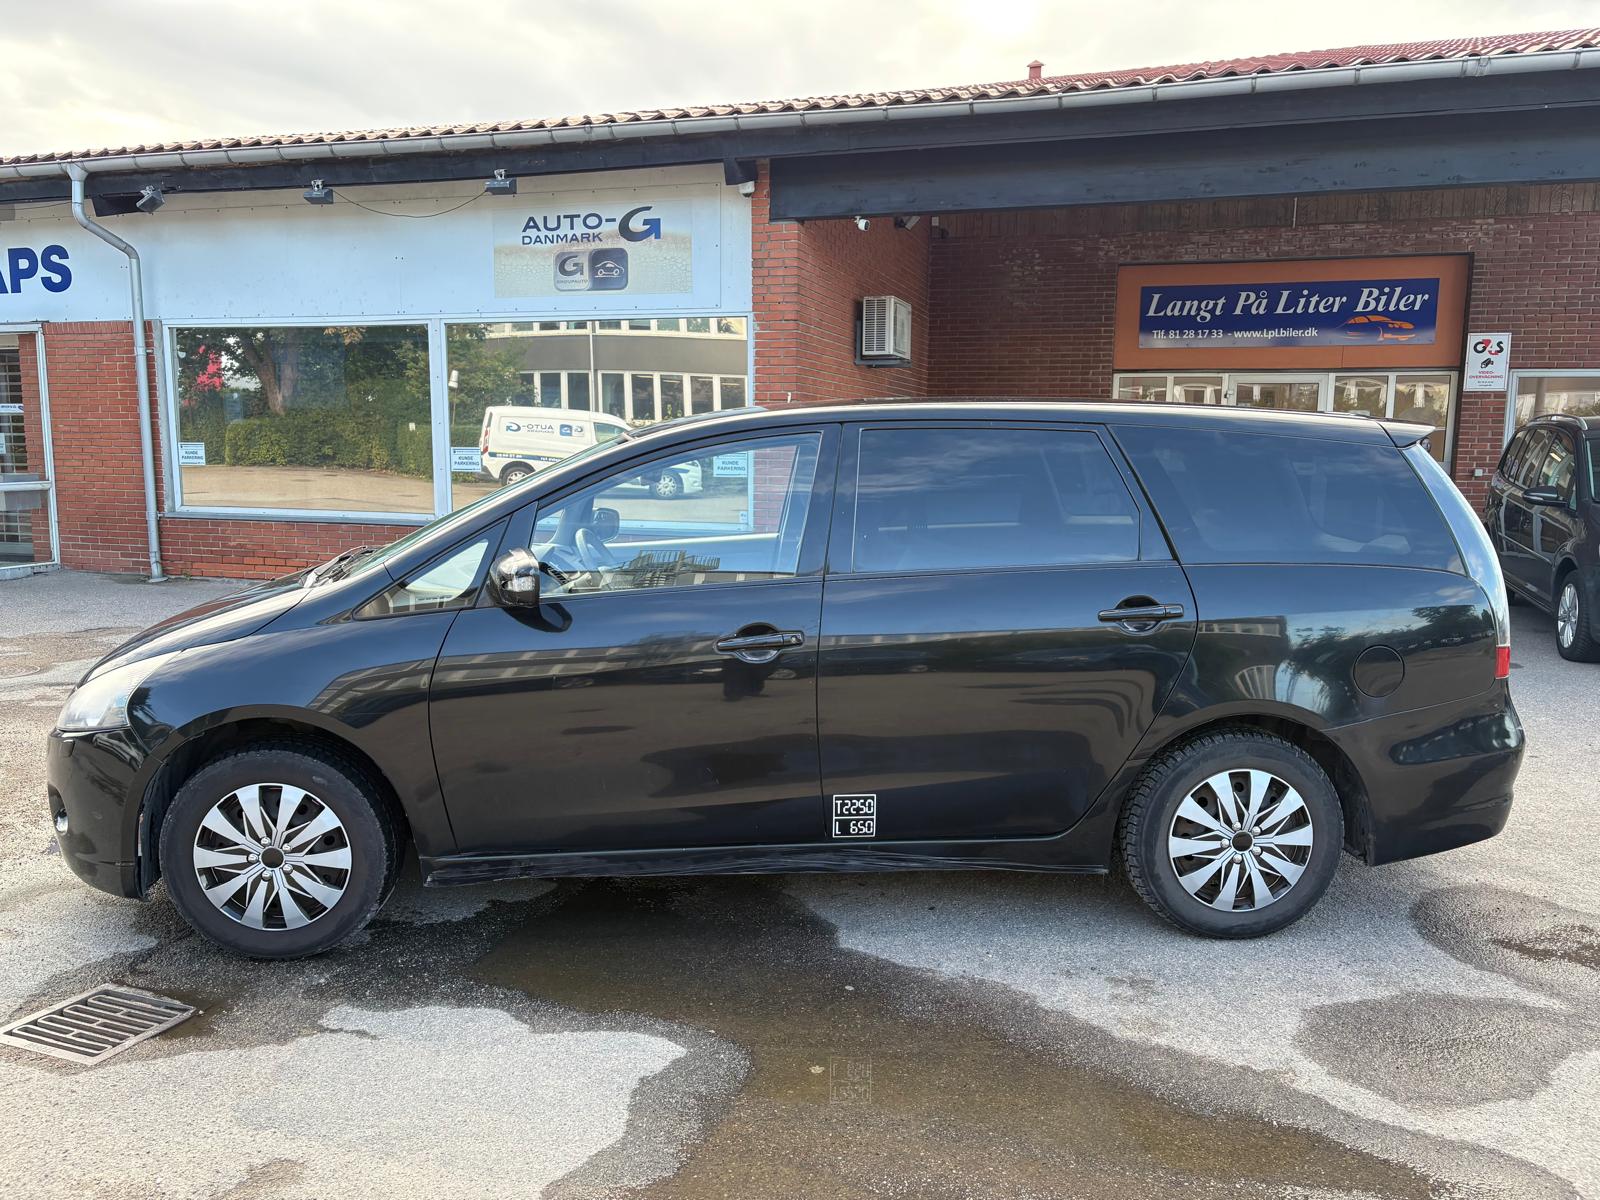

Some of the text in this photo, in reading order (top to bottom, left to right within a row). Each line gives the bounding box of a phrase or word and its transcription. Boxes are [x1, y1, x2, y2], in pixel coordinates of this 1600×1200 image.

[522, 233, 603, 245] DANMARK
[1146, 287, 1429, 323] Langt På Liter Biler
[1152, 329, 1167, 340] Tlf.
[1168, 329, 1180, 339] 81
[1182, 329, 1196, 339] 28
[1197, 329, 1208, 339] 17
[1210, 329, 1223, 338] 33
[836, 821, 874, 834] L 650
